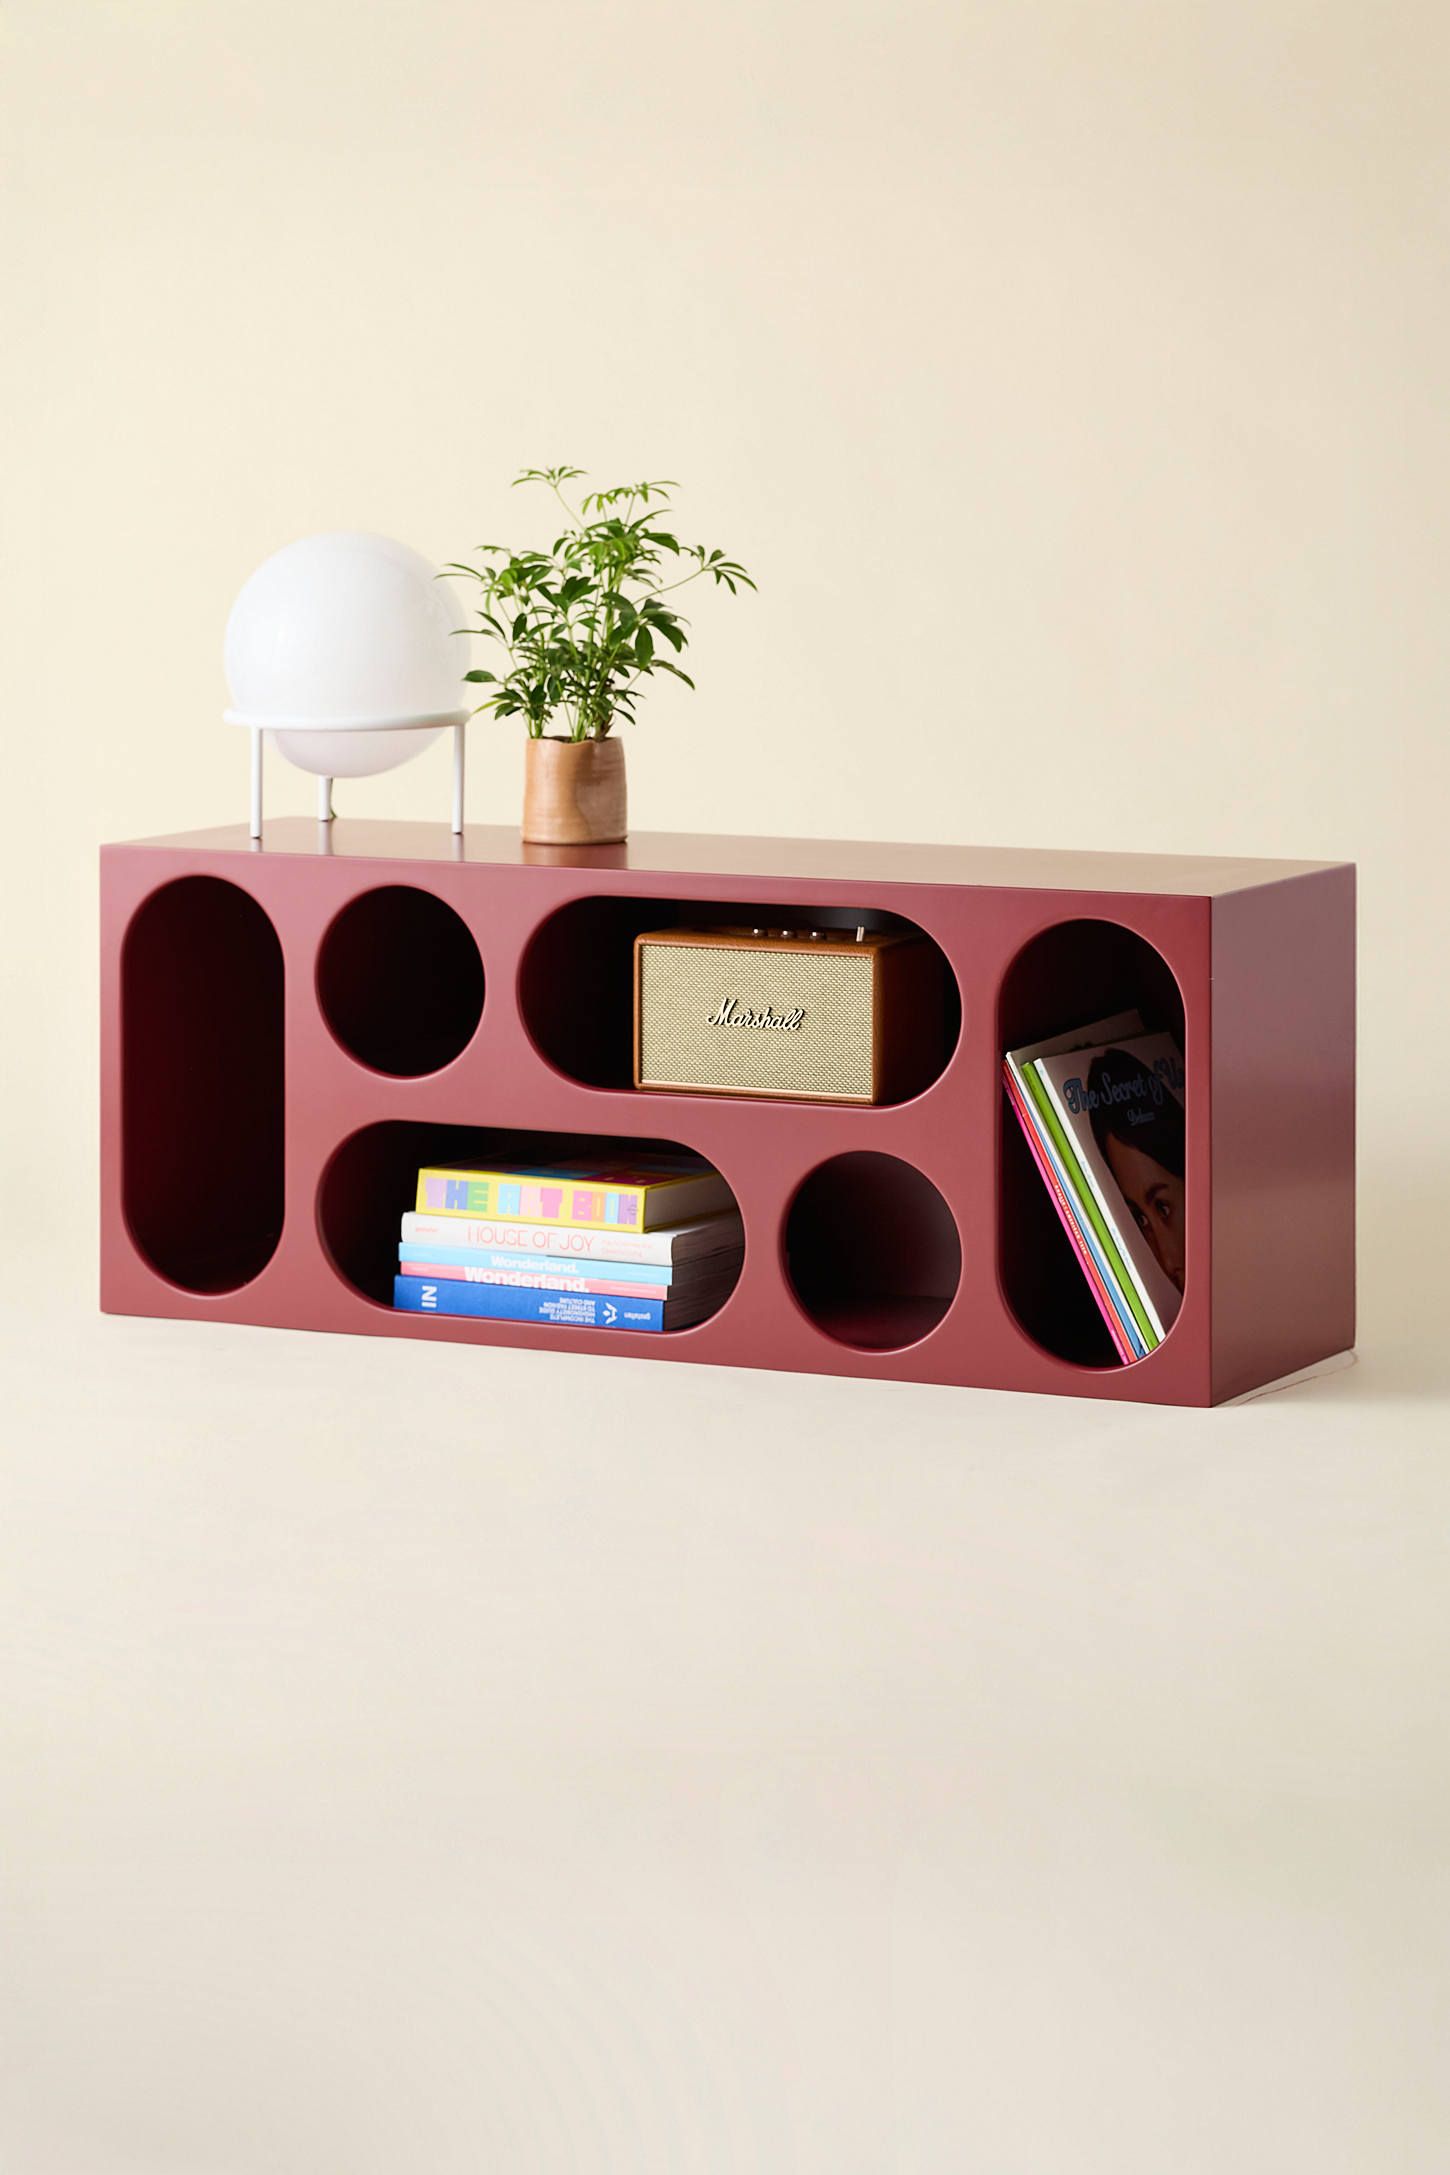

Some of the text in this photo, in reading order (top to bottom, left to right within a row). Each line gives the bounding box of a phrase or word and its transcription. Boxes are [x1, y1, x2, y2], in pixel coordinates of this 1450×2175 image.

[706, 996, 804, 1031] Marshall
[1062, 1077, 1099, 1115] The
[1101, 1071, 1148, 1105] Secret
[425, 1176, 639, 1226] THE ART BOOK
[466, 1224, 528, 1248] HOUSE
[532, 1229, 556, 1250] OF
[559, 1231, 596, 1254] JOY
[463, 1265, 591, 1294] Wonderland.
[489, 1254, 580, 1274] Wonderland.
